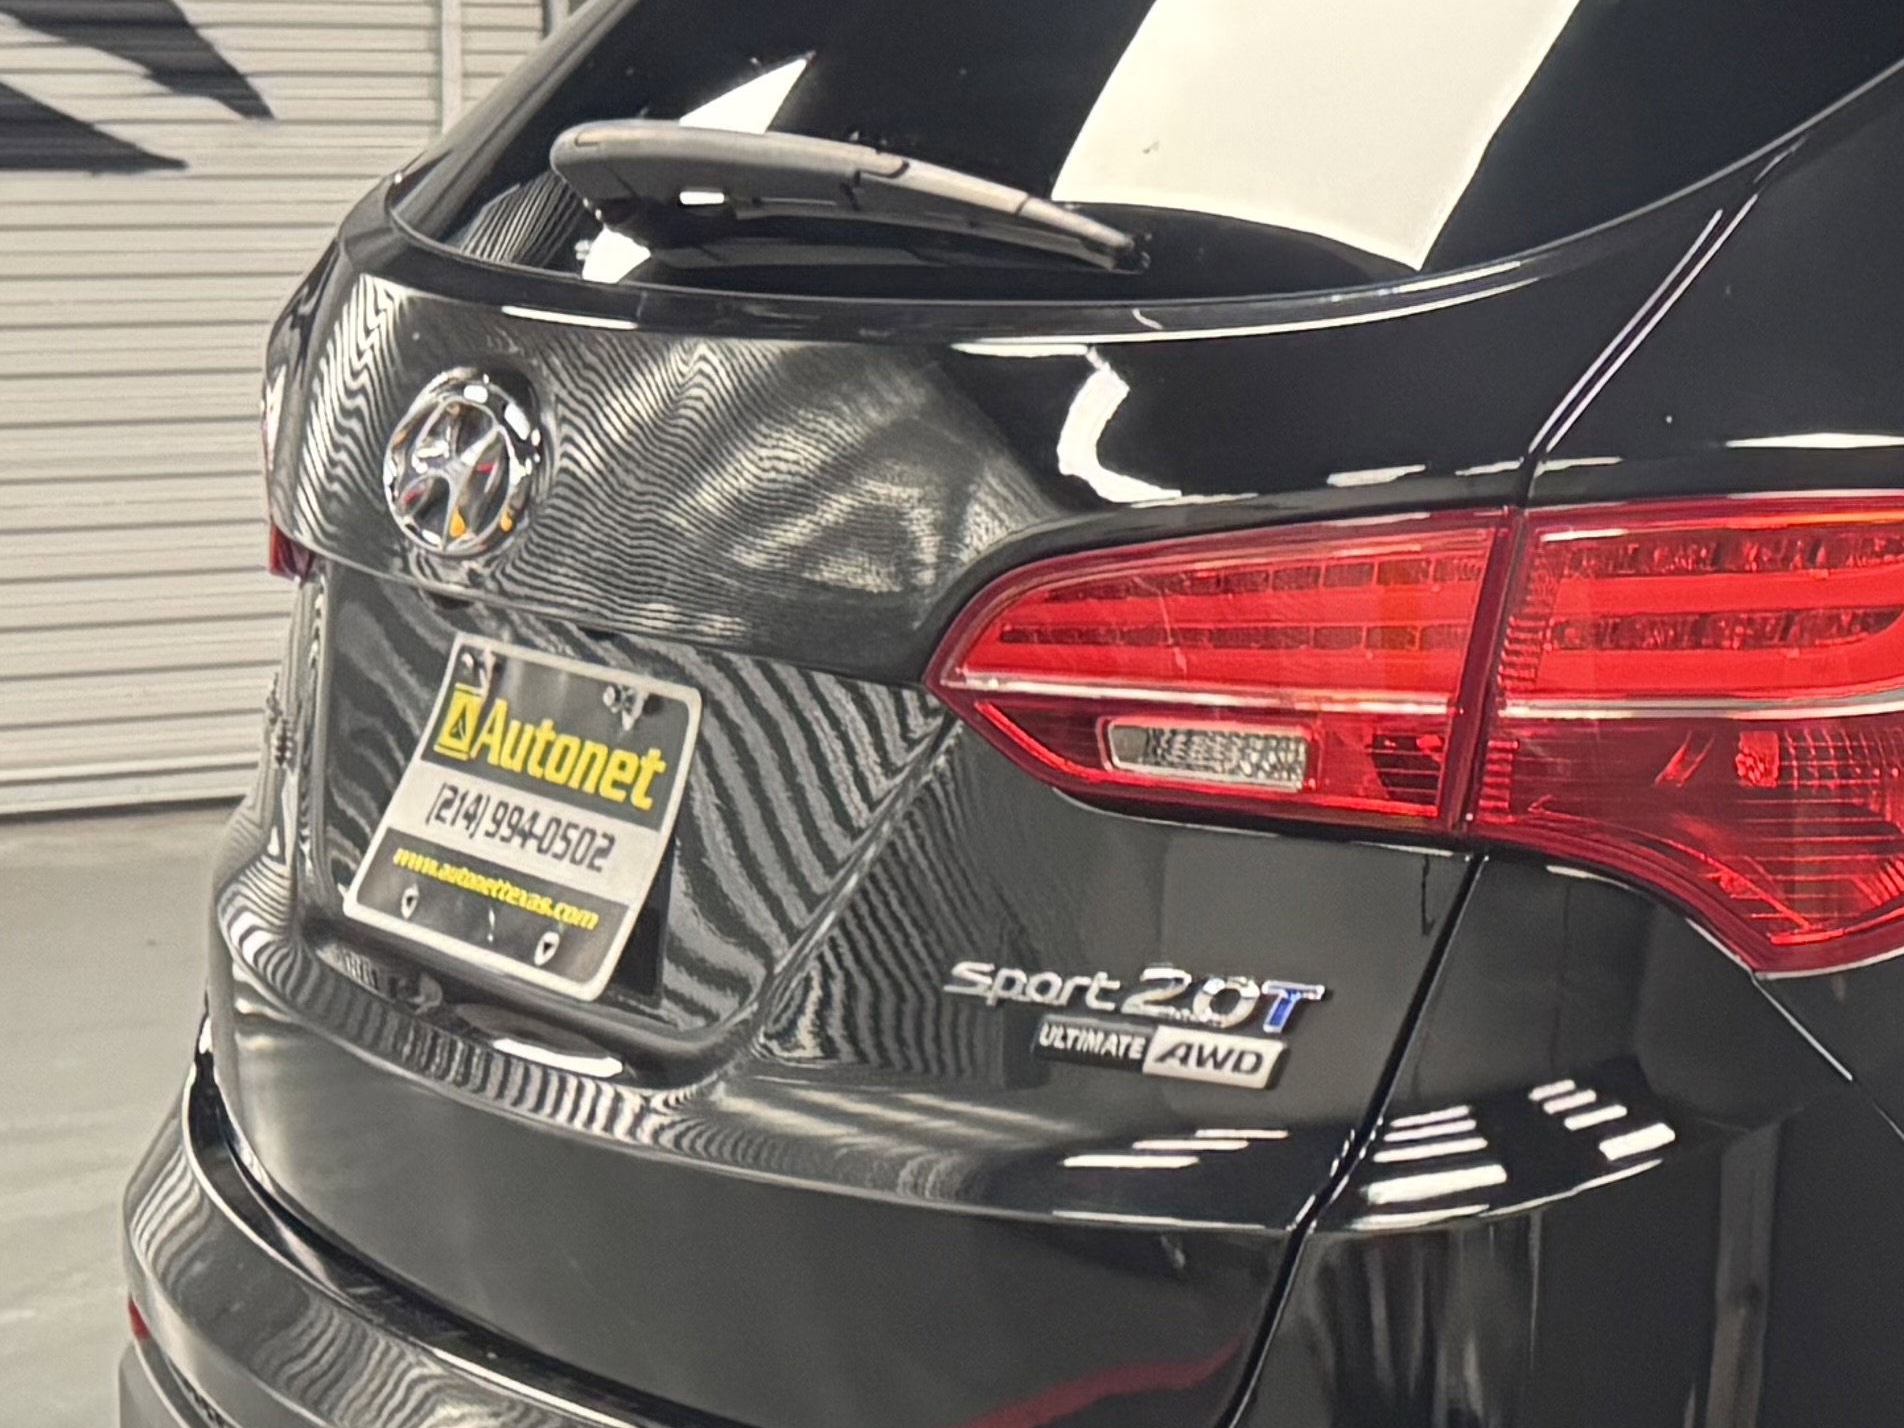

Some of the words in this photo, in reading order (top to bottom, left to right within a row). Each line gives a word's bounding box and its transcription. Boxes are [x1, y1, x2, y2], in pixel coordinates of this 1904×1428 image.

[470, 698, 667, 811] Autonet
[425, 782, 490, 840] (214)
[484, 801, 616, 873] 994-0502
[392, 847, 600, 930] www.autonettexas.com
[1038, 1024, 1147, 1060] ULTIMATE
[1153, 1042, 1265, 1075] AWD
